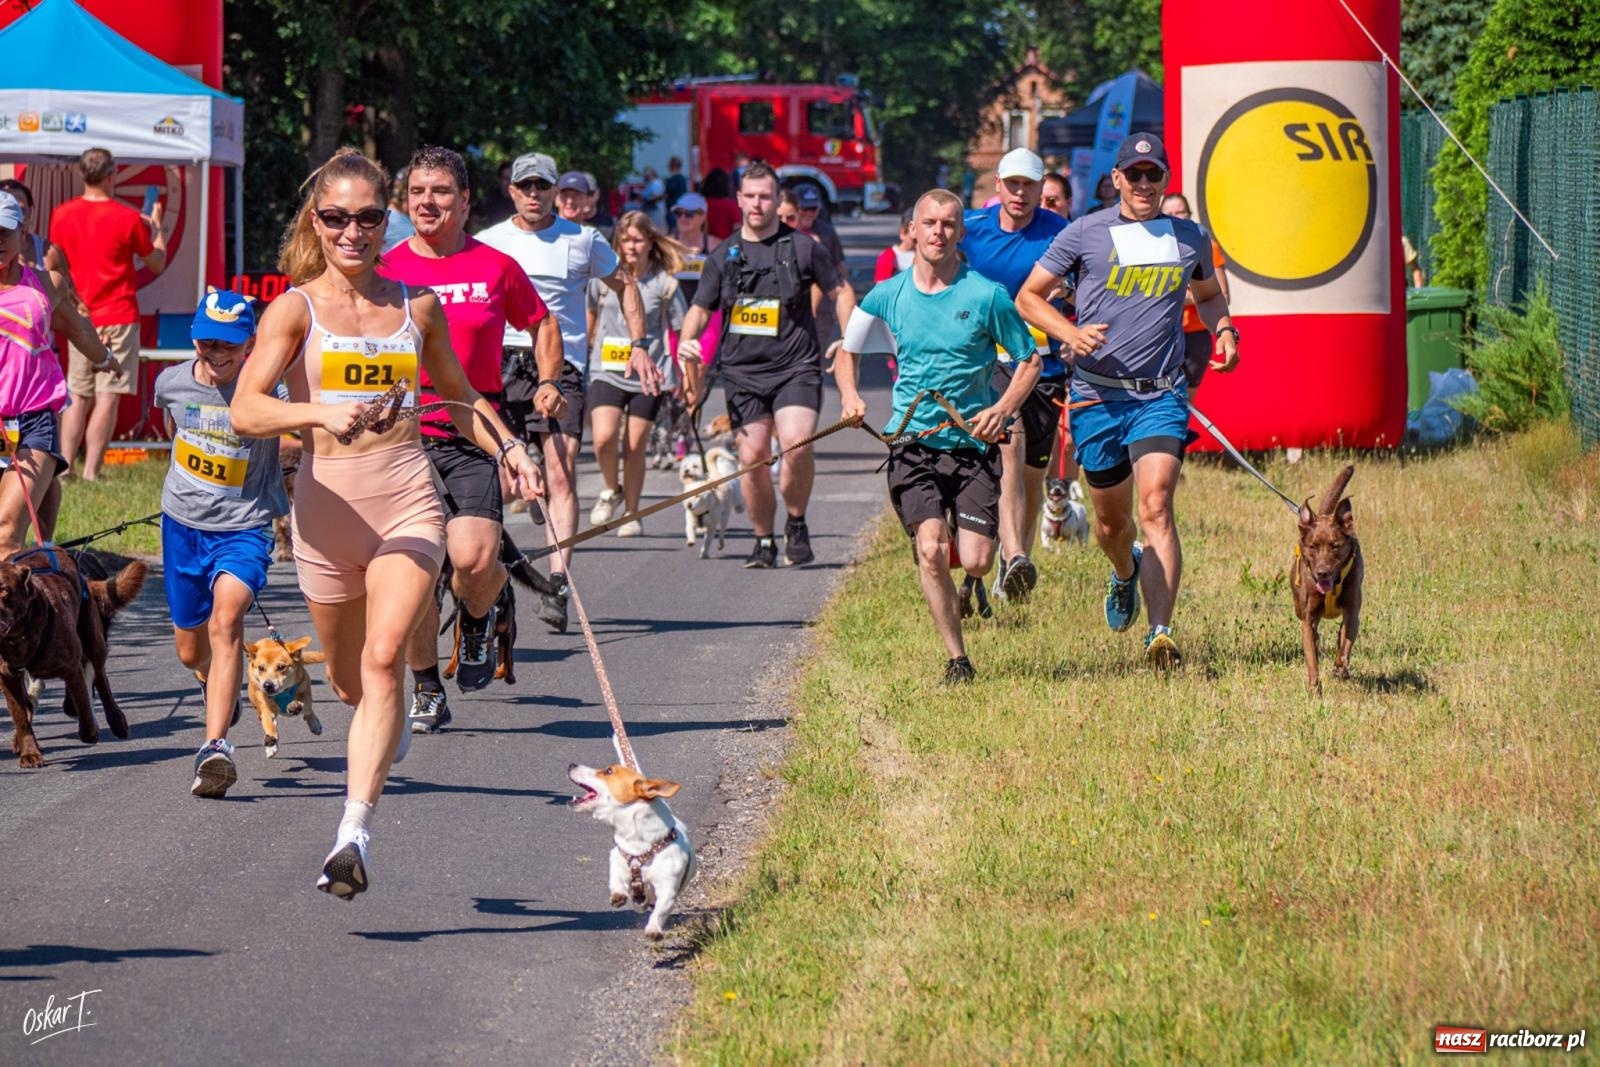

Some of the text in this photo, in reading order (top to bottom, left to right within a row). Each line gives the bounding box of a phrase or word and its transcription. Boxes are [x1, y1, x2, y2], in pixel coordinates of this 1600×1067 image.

[1283, 121, 1372, 161] SIR
[1106, 264, 1184, 297] LIMITS
[741, 312, 768, 323] 005
[344, 363, 394, 385] 021
[187, 454, 227, 481] 031
